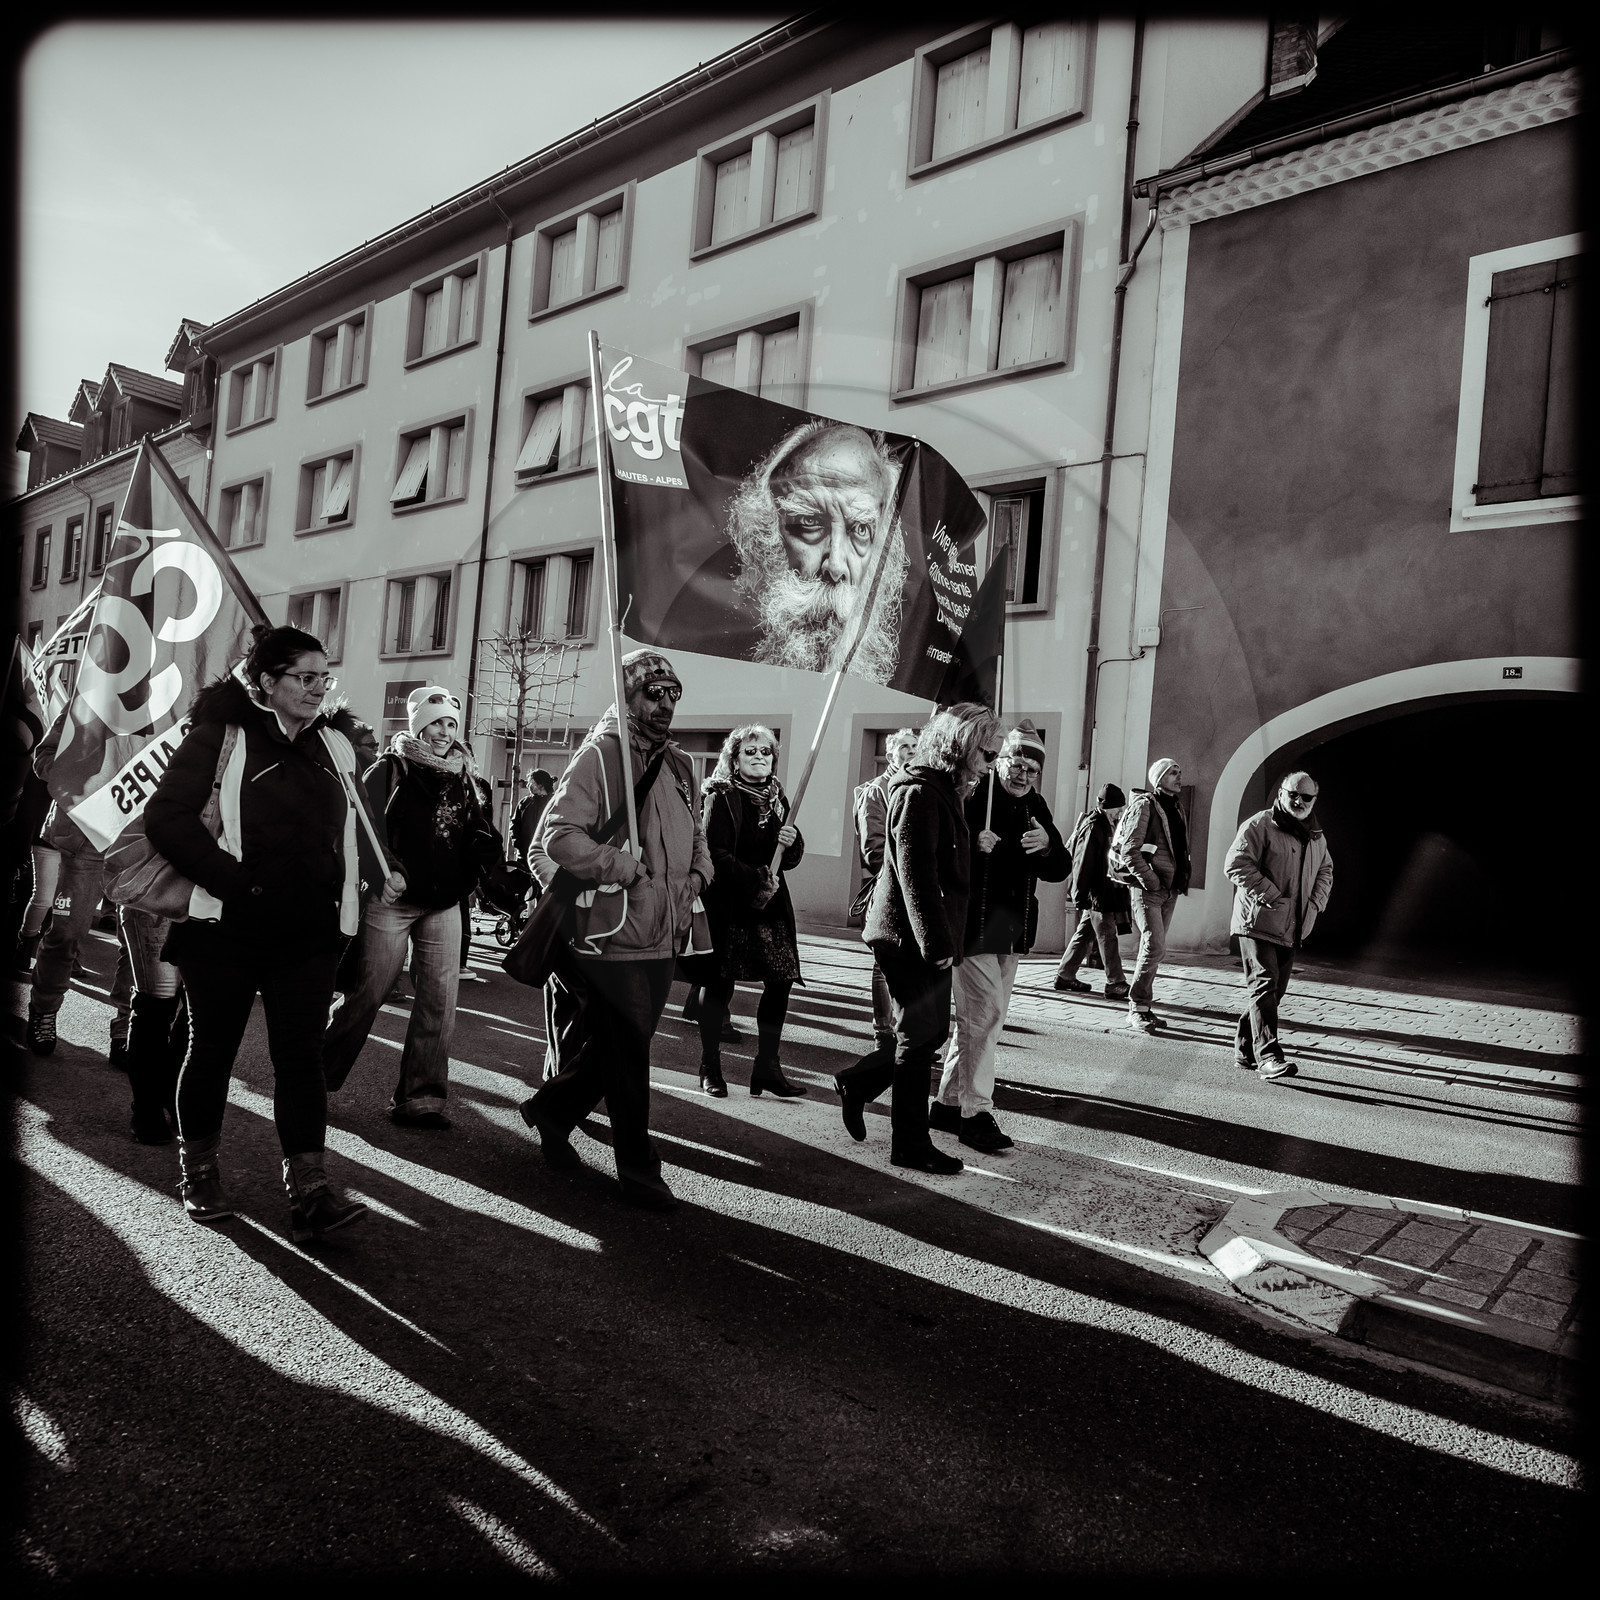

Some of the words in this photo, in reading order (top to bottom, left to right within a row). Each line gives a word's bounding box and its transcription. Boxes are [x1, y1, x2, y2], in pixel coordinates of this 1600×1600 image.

[604, 393, 685, 460] cgt
[617, 468, 648, 482] HAUTES
[655, 474, 683, 486] ALPES
